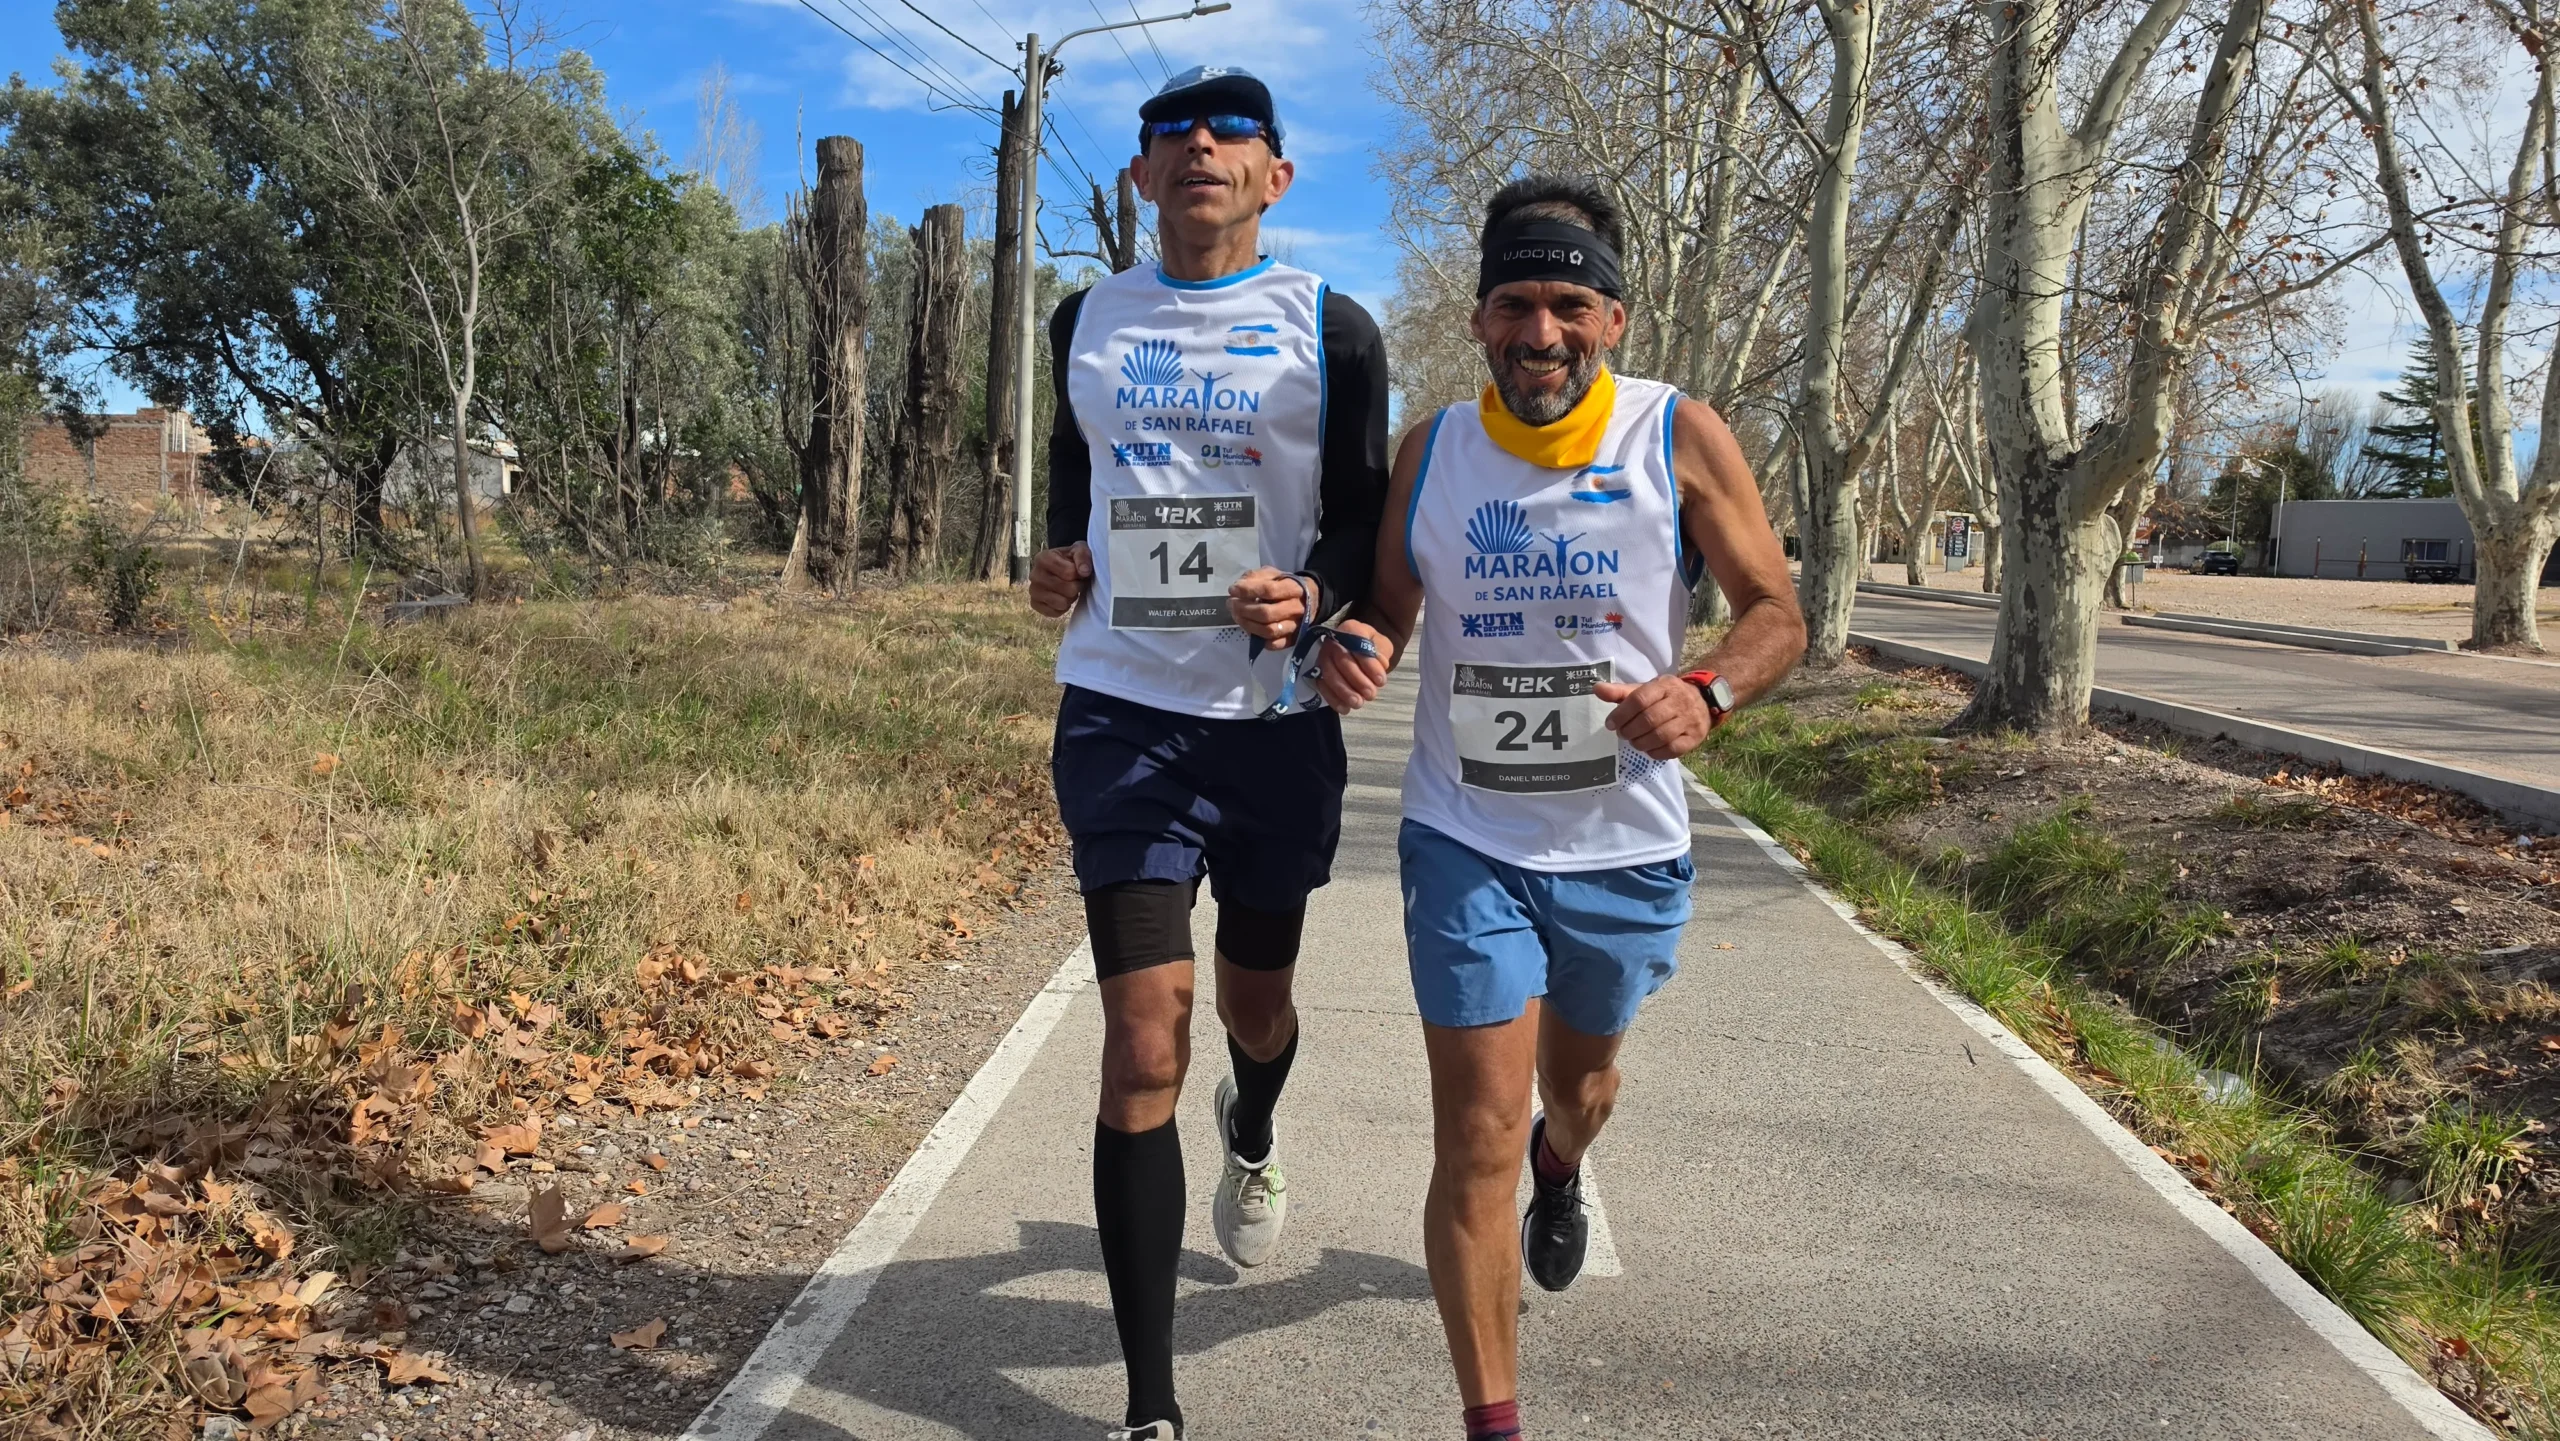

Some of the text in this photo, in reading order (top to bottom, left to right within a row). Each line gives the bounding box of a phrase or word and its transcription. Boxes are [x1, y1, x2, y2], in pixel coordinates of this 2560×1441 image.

[1116, 383, 1260, 414] MARATON
[1125, 416, 1255, 436] DE SAN RAFAEL
[1133, 443, 1171, 456] UTN
[1223, 501, 1243, 509] UTN
[1154, 506, 1203, 524] 42K
[1149, 541, 1214, 585] 14
[1465, 548, 1619, 580] MARATON
[1475, 583, 1618, 601] DE SAN RAFAEL
[1148, 608, 1217, 617] WALTER ALVAREZ
[1482, 612, 1524, 626] UTN
[1483, 624, 1525, 632] DEPORTES
[1576, 668, 1597, 677] UTN
[1502, 676, 1556, 693] 42K
[1494, 709, 1569, 751] 24
[1532, 774, 1570, 782] MEDERO
